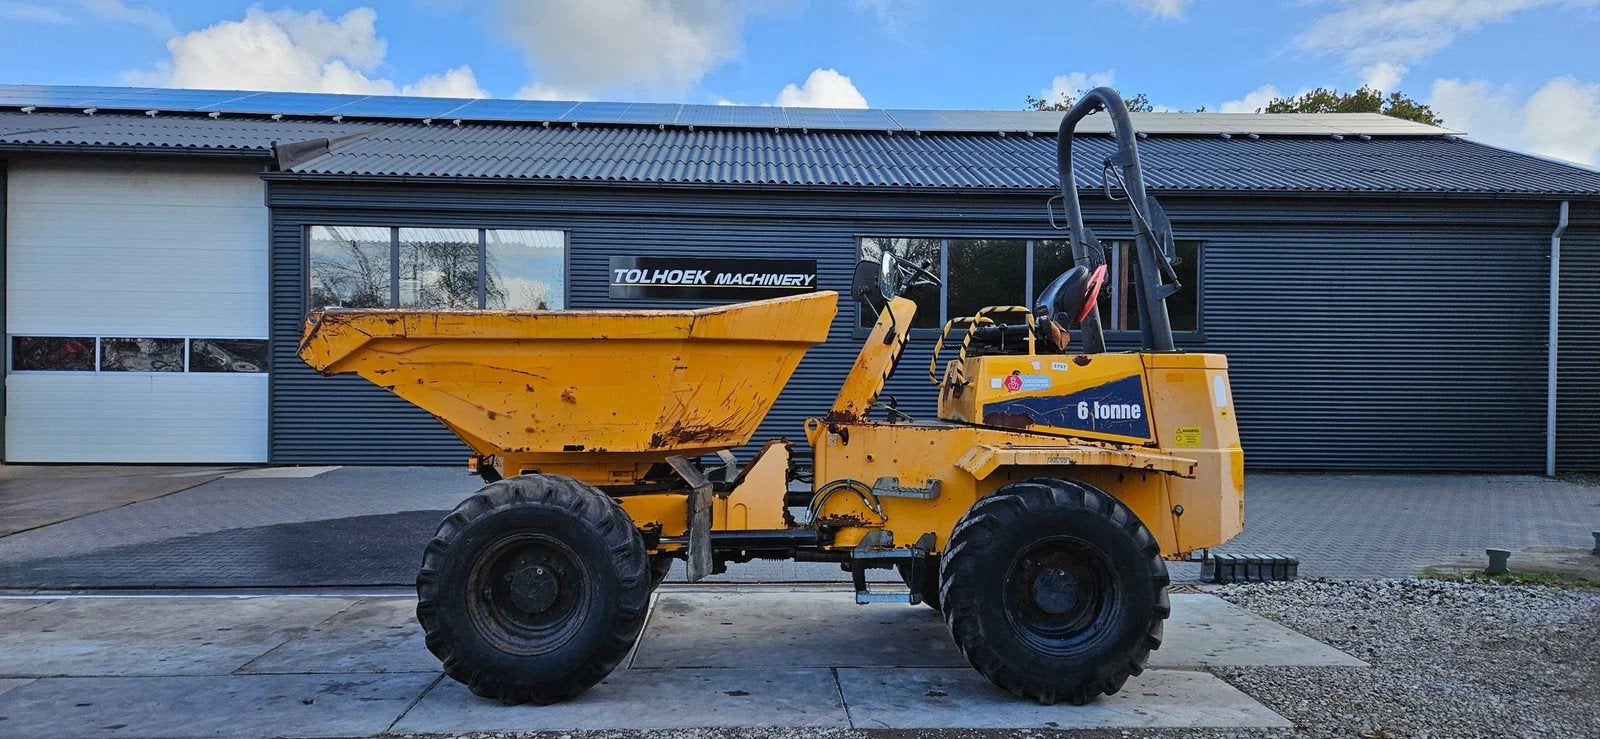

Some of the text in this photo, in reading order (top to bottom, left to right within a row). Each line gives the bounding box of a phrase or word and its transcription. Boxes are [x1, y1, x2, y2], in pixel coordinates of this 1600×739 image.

[613, 268, 816, 286] TOLHOEK MACHINERY
[1077, 401, 1141, 420] 6 tonne
